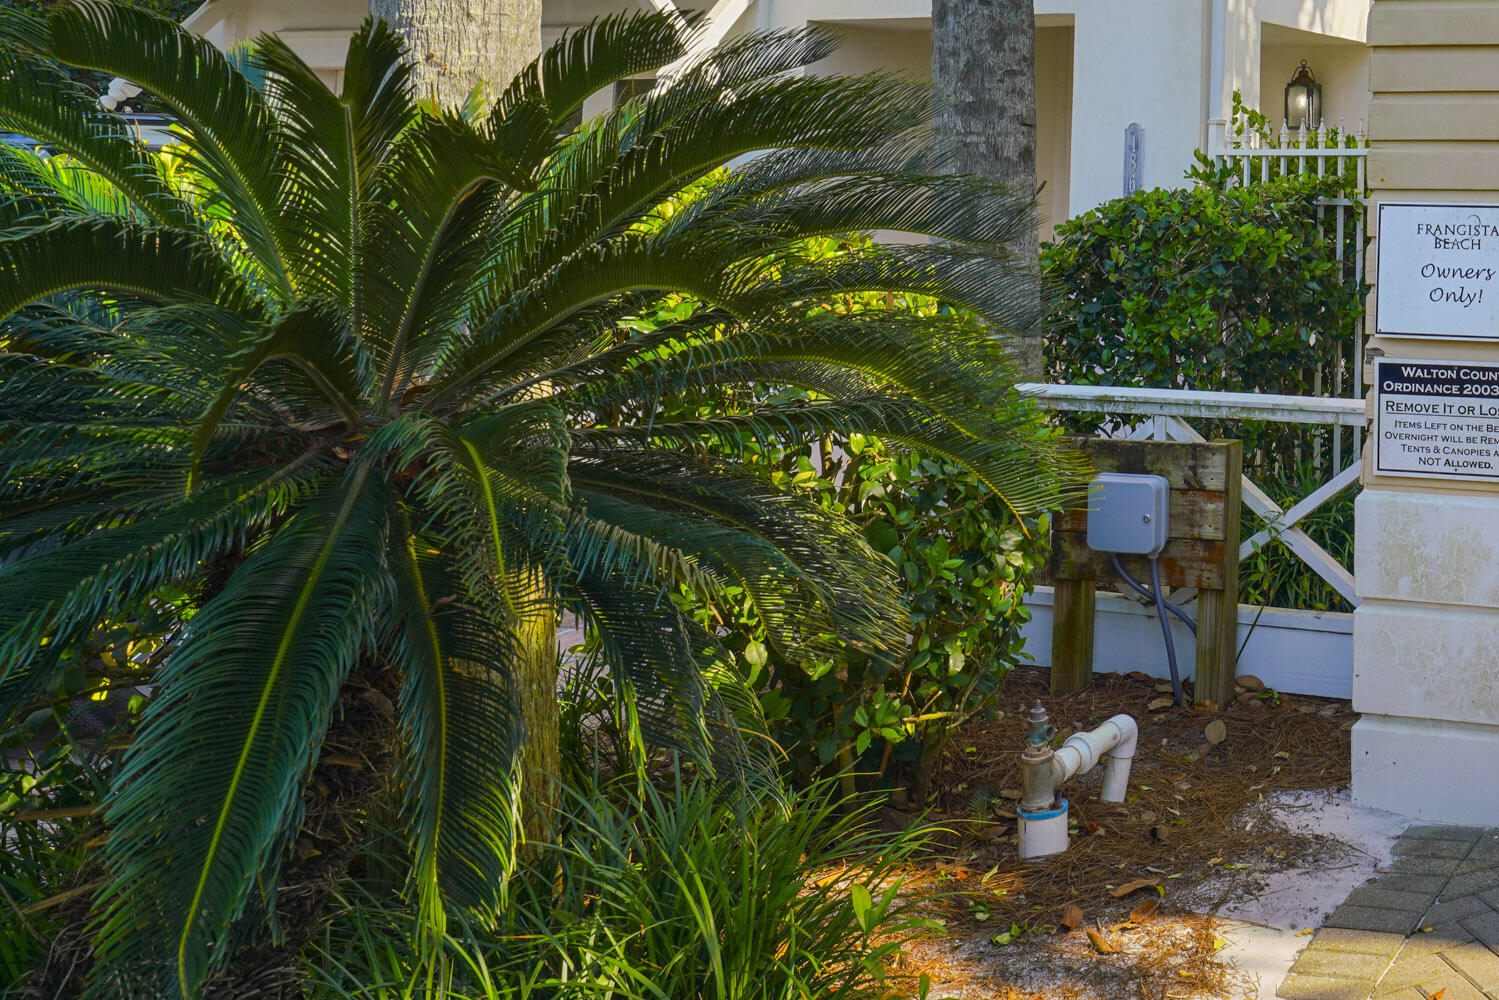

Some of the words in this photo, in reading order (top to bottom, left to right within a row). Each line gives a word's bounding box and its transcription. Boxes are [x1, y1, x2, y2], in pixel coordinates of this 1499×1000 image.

[1417, 223, 1499, 237] FRANGISTA
[1434, 238, 1481, 250] BEACH
[1421, 263, 1496, 281] Owners
[1429, 286, 1483, 308] Only!
[1401, 367, 1457, 379] WALTON
[1383, 381, 1460, 394] ORDINANCE
[1386, 400, 1439, 414] REMOVE
[1443, 403, 1454, 414] IT
[1457, 405, 1476, 415] OR
[1394, 420, 1422, 429] ITEMS
[1424, 421, 1447, 430] LEFT
[1384, 431, 1438, 442] OVERNIGHT
[1401, 444, 1430, 454] TENTS
[1433, 446, 1441, 454] &
[1442, 446, 1491, 457] CANOPIES
[1418, 457, 1441, 466] NOT
[1444, 458, 1494, 469] ALLOWED.
